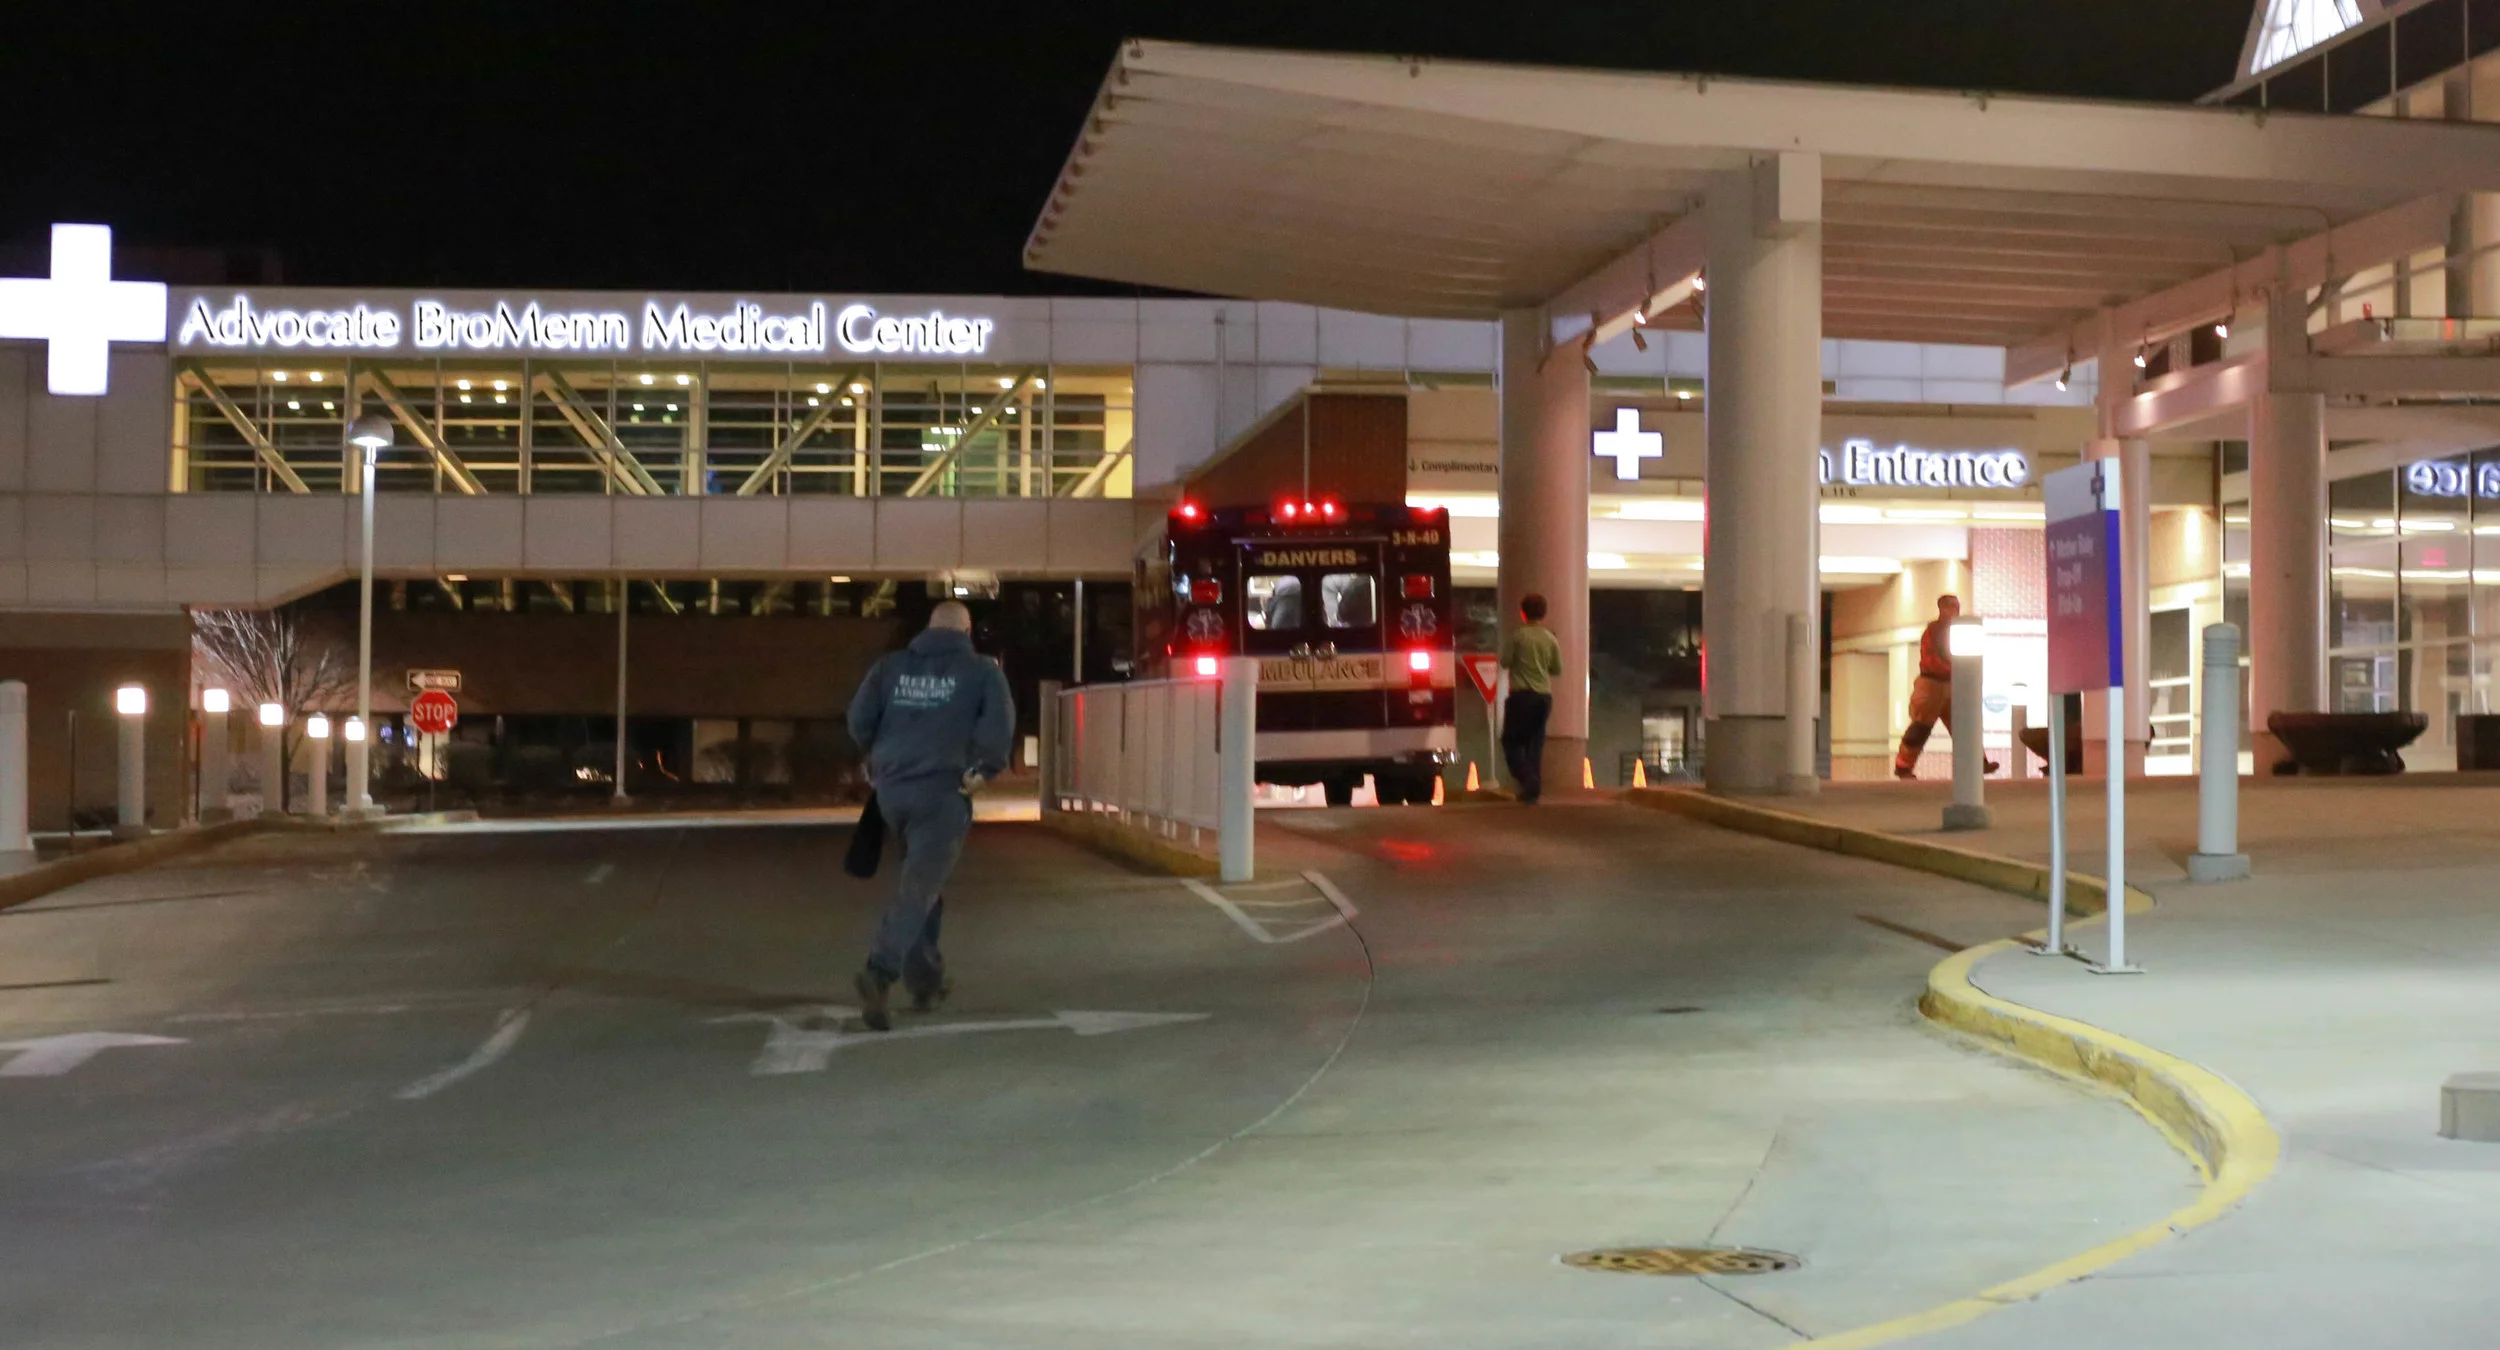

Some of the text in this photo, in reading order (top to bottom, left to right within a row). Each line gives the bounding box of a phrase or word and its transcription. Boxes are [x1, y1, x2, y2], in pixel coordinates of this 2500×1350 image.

[180, 295, 994, 355] Advocate BroMenn Medical Center
[1421, 460, 1499, 475] Complimentary
[1844, 440, 2027, 487] Entrance
[1263, 549, 1358, 567] DANVERS
[1259, 657, 1381, 681] MBULANCE
[414, 702, 454, 722] STOP
